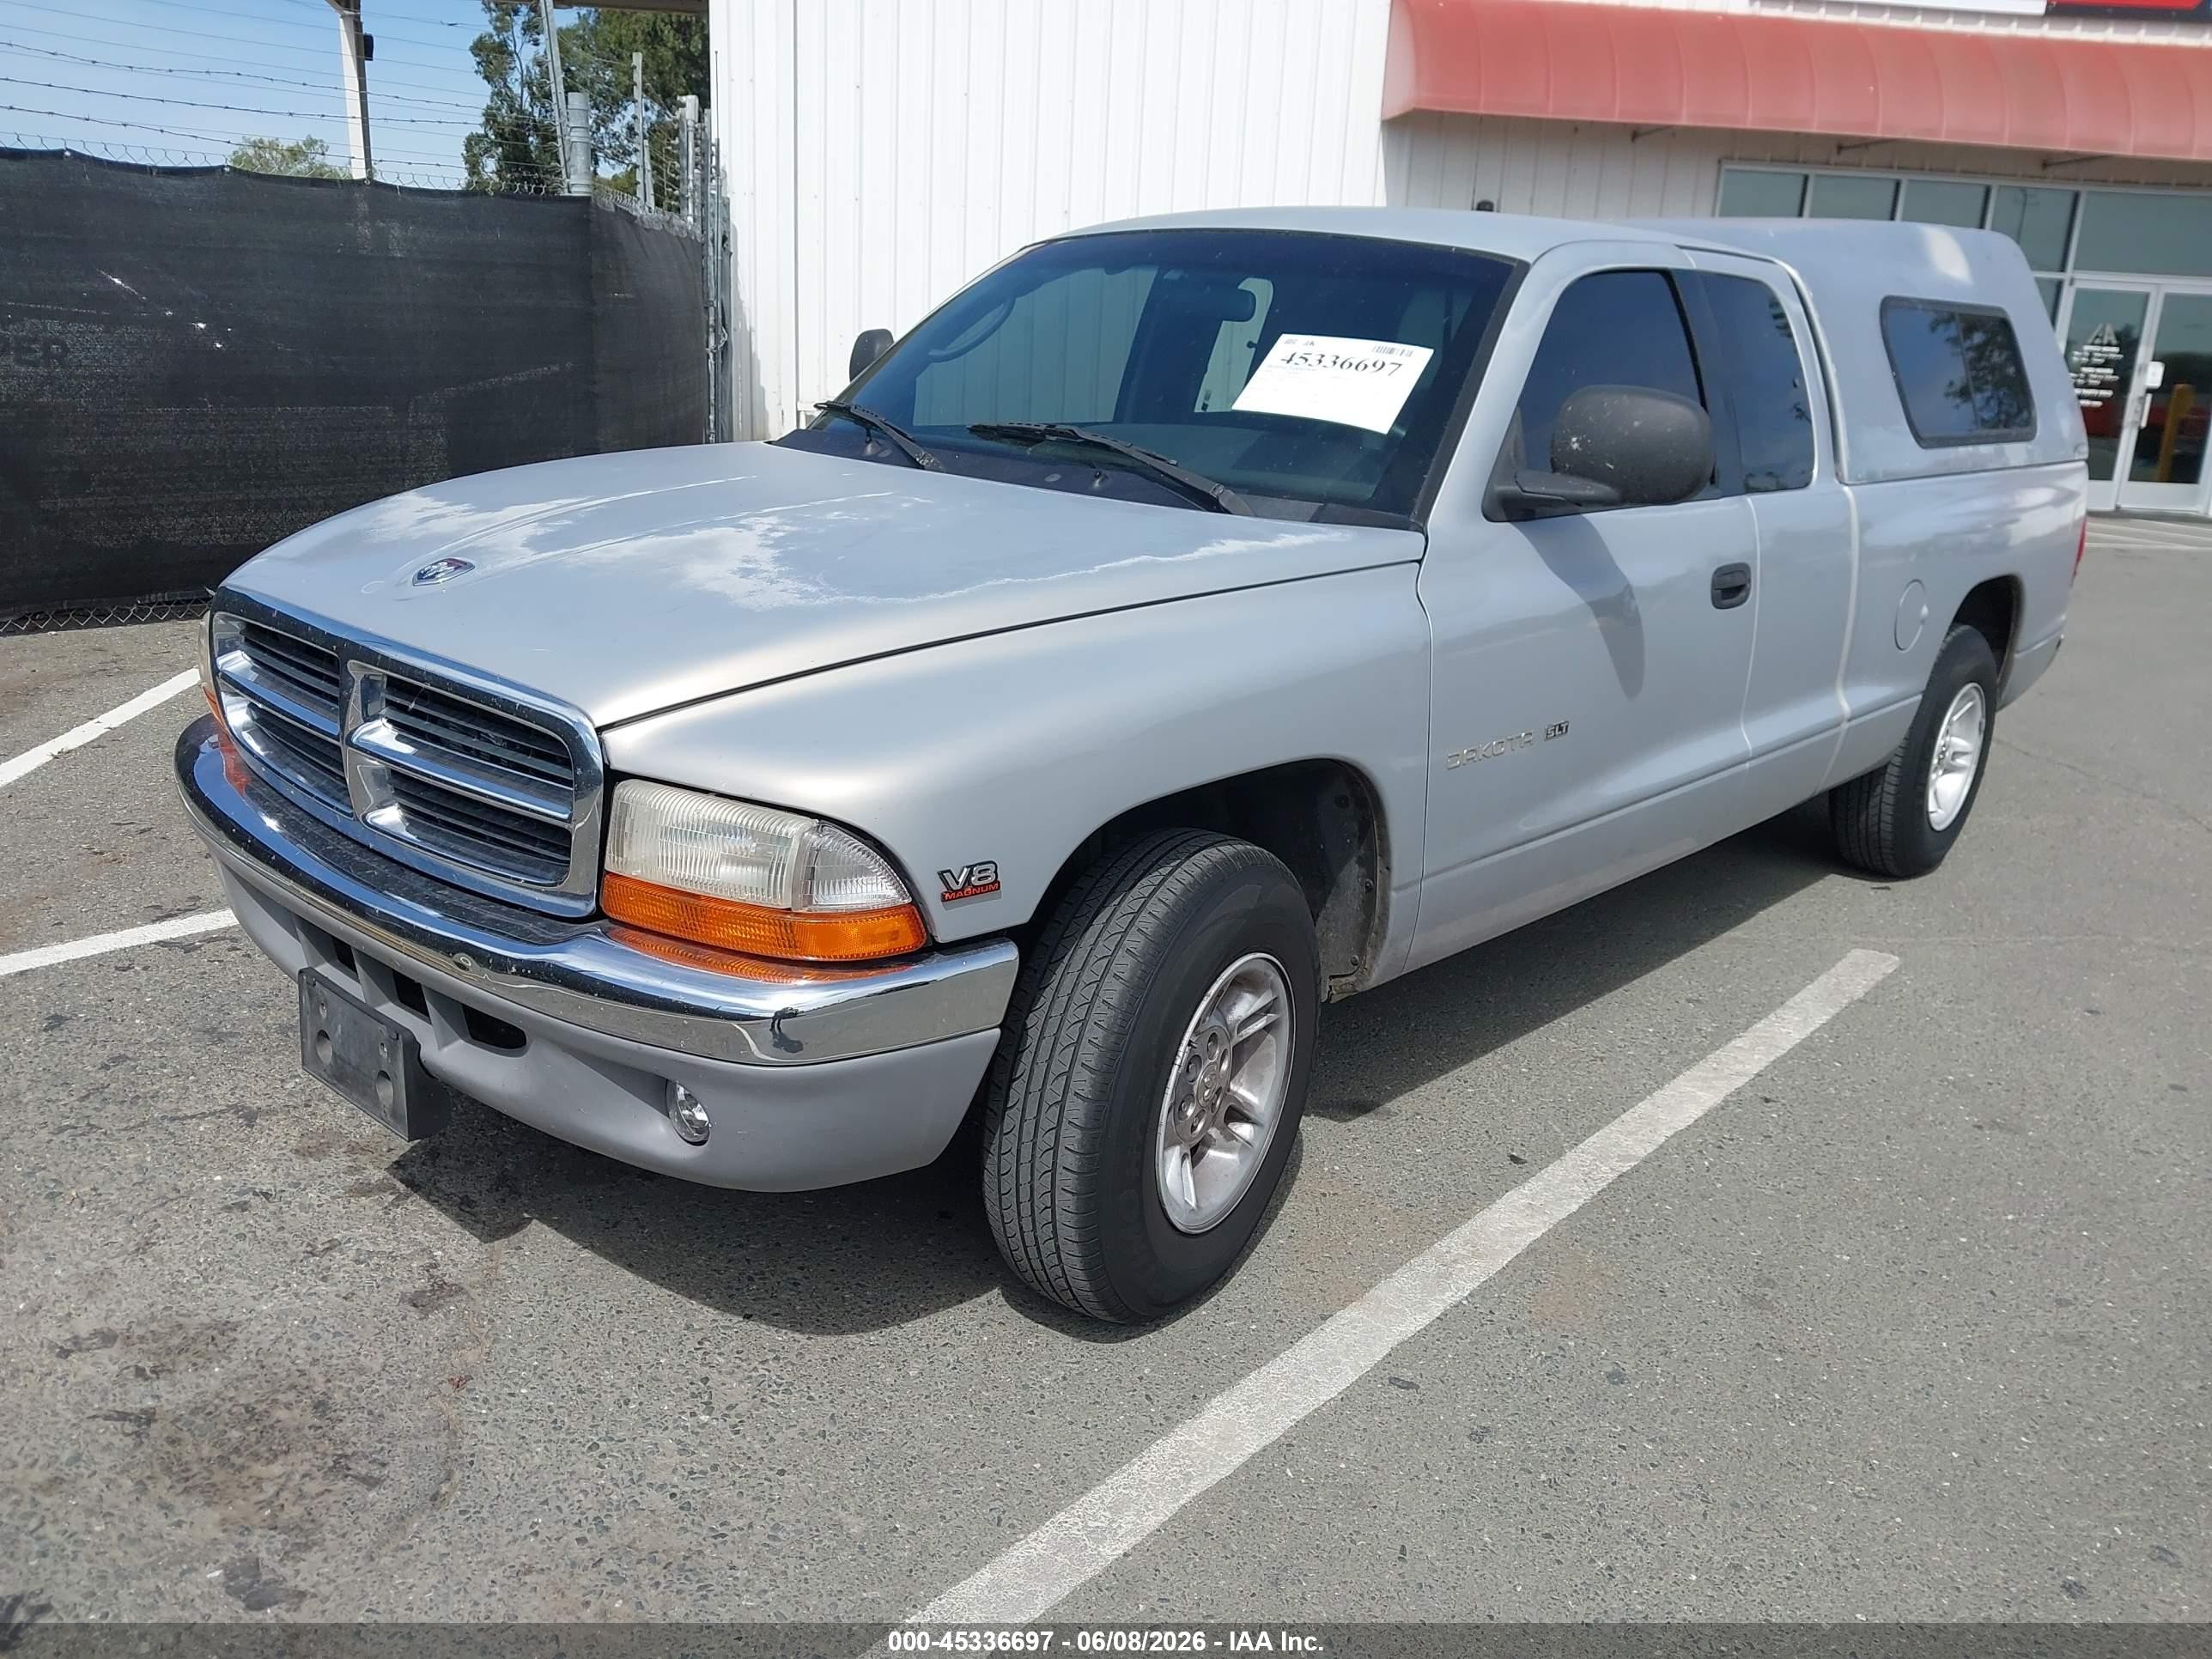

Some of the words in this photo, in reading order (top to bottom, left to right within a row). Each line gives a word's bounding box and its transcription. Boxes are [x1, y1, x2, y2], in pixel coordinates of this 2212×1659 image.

[1280, 350, 1403, 377] 45336697
[1447, 729, 1534, 771] DAKOTA
[1545, 720, 1570, 740] SLT
[939, 861, 999, 891] V8
[942, 883, 1000, 902] MAGNUM
